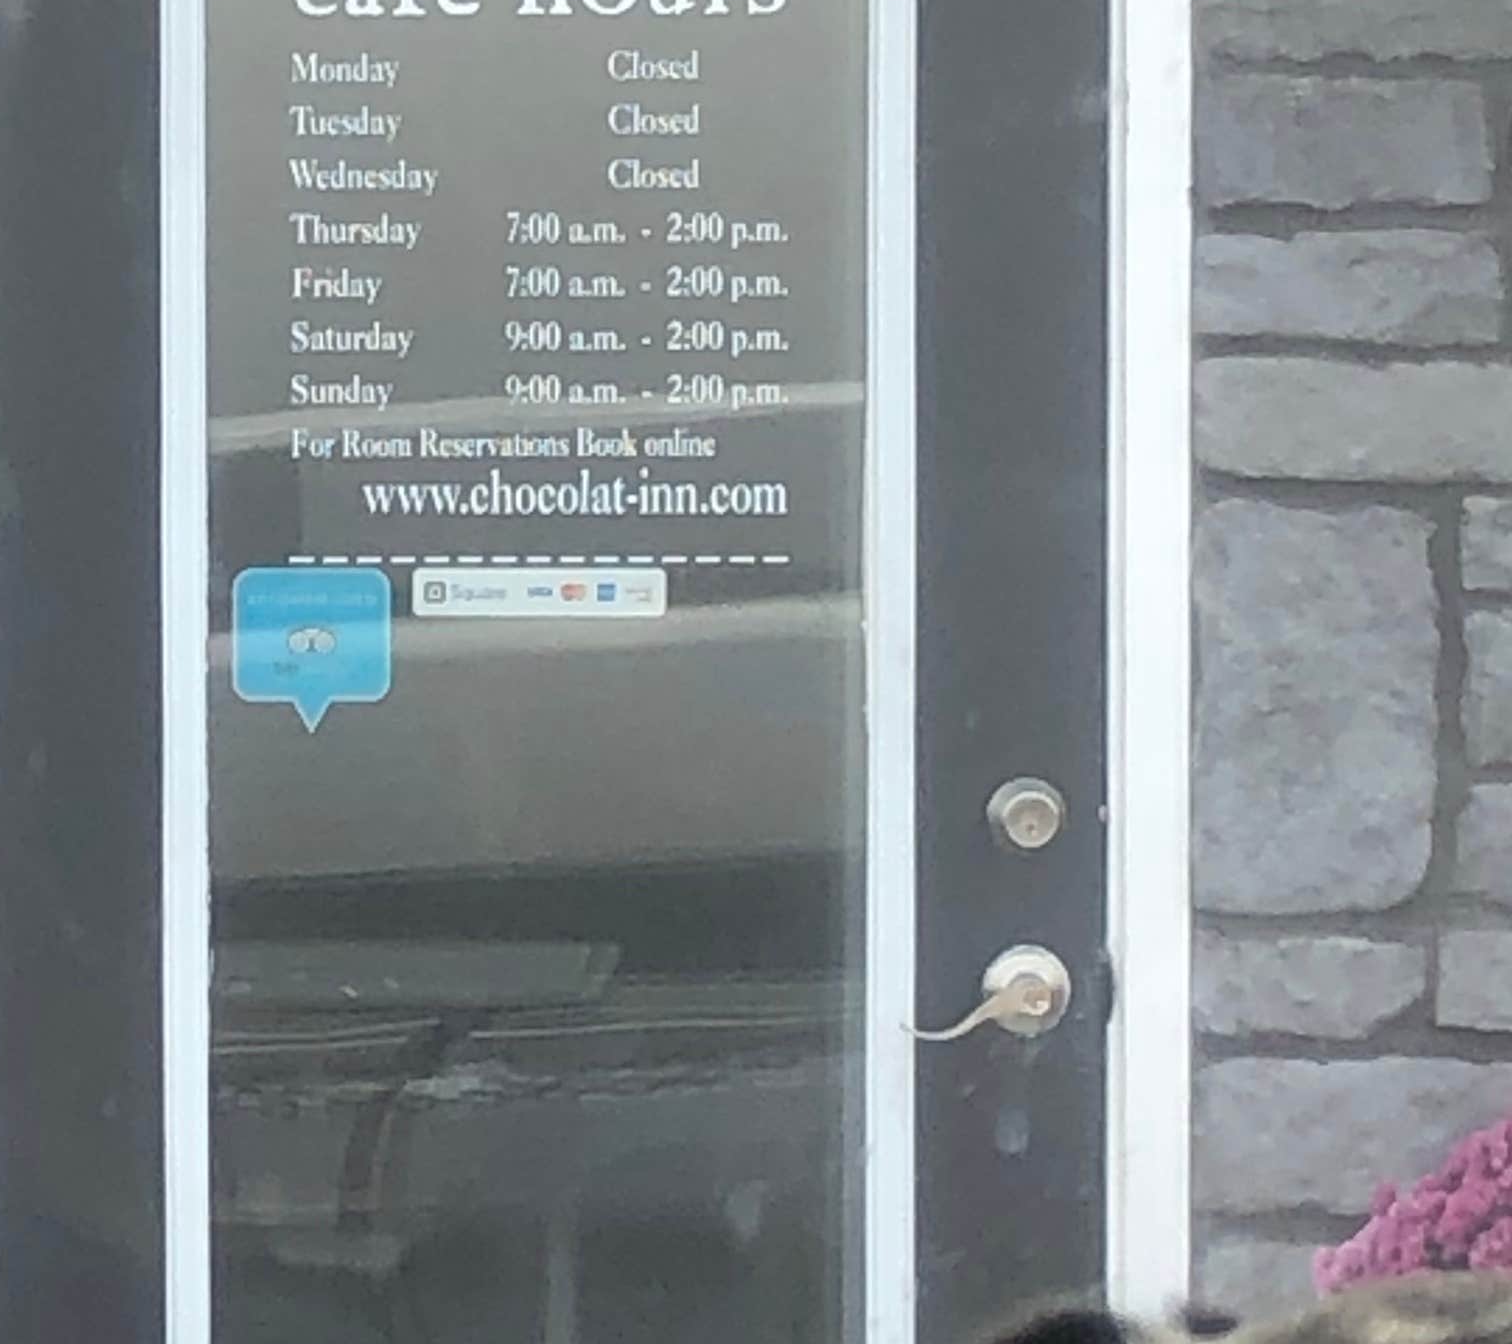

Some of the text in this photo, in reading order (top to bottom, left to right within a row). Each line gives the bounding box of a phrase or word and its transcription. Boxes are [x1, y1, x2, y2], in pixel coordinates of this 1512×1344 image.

[291, 50, 700, 86] Monday Closed
[290, 103, 700, 140] Tuesday Closed
[290, 158, 700, 192] Wednesday Closed
[291, 212, 422, 249] Thursday
[505, 211, 561, 245] 7:00
[568, 222, 626, 246] a.m.
[666, 211, 723, 245] 2:00
[730, 222, 789, 251] p.m.
[292, 267, 383, 301] Friday
[505, 266, 561, 298] 7:00
[568, 277, 626, 299] a.m.
[666, 266, 723, 298] 2:00
[730, 277, 789, 304] p.m.
[291, 319, 414, 356] Saturday
[505, 320, 561, 351] 9:00
[568, 331, 626, 352] a.m.
[666, 320, 723, 351] 2:00
[730, 331, 789, 357] p.m.
[291, 374, 393, 409] Sunday
[505, 374, 561, 405] 9:00
[568, 385, 626, 406] a.m.
[666, 374, 723, 405] 2:00
[730, 385, 789, 411] p.m.
[291, 427, 716, 458] For Room Reservations Book online
[362, 468, 788, 516] www.chocolat-inn.com
